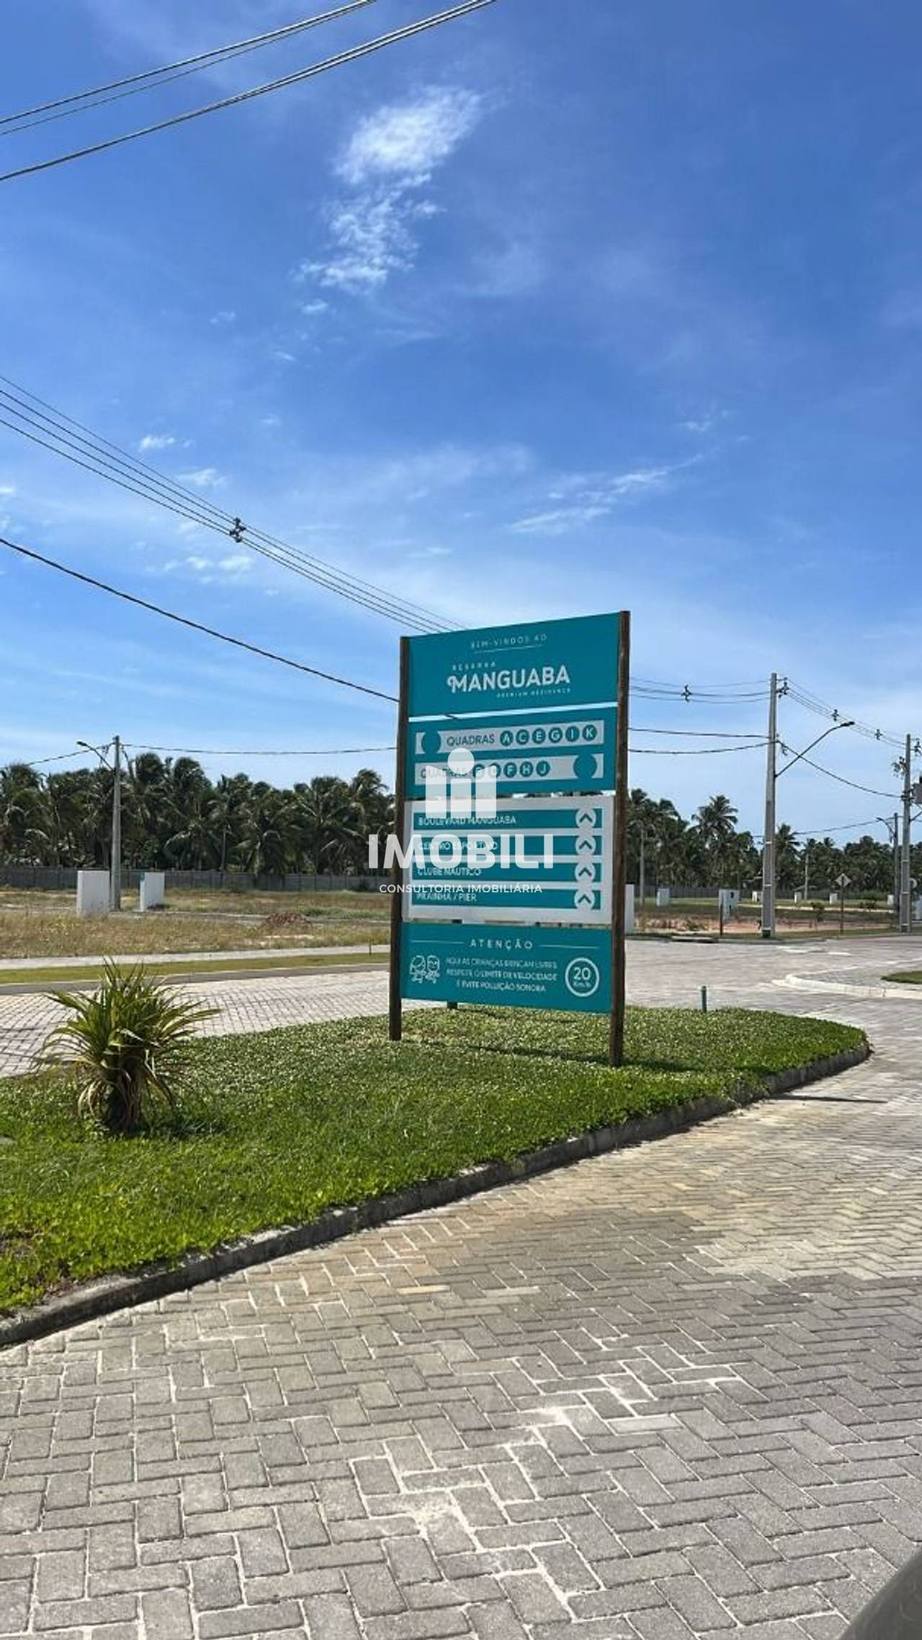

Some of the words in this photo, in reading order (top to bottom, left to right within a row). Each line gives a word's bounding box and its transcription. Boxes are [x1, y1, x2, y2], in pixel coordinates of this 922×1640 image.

[447, 665, 570, 694] MANGUABA
[446, 733, 496, 747] QUADRAS
[459, 893, 477, 902] PIER
[470, 938, 533, 951] ATENÇÃO
[573, 966, 592, 981] 20
